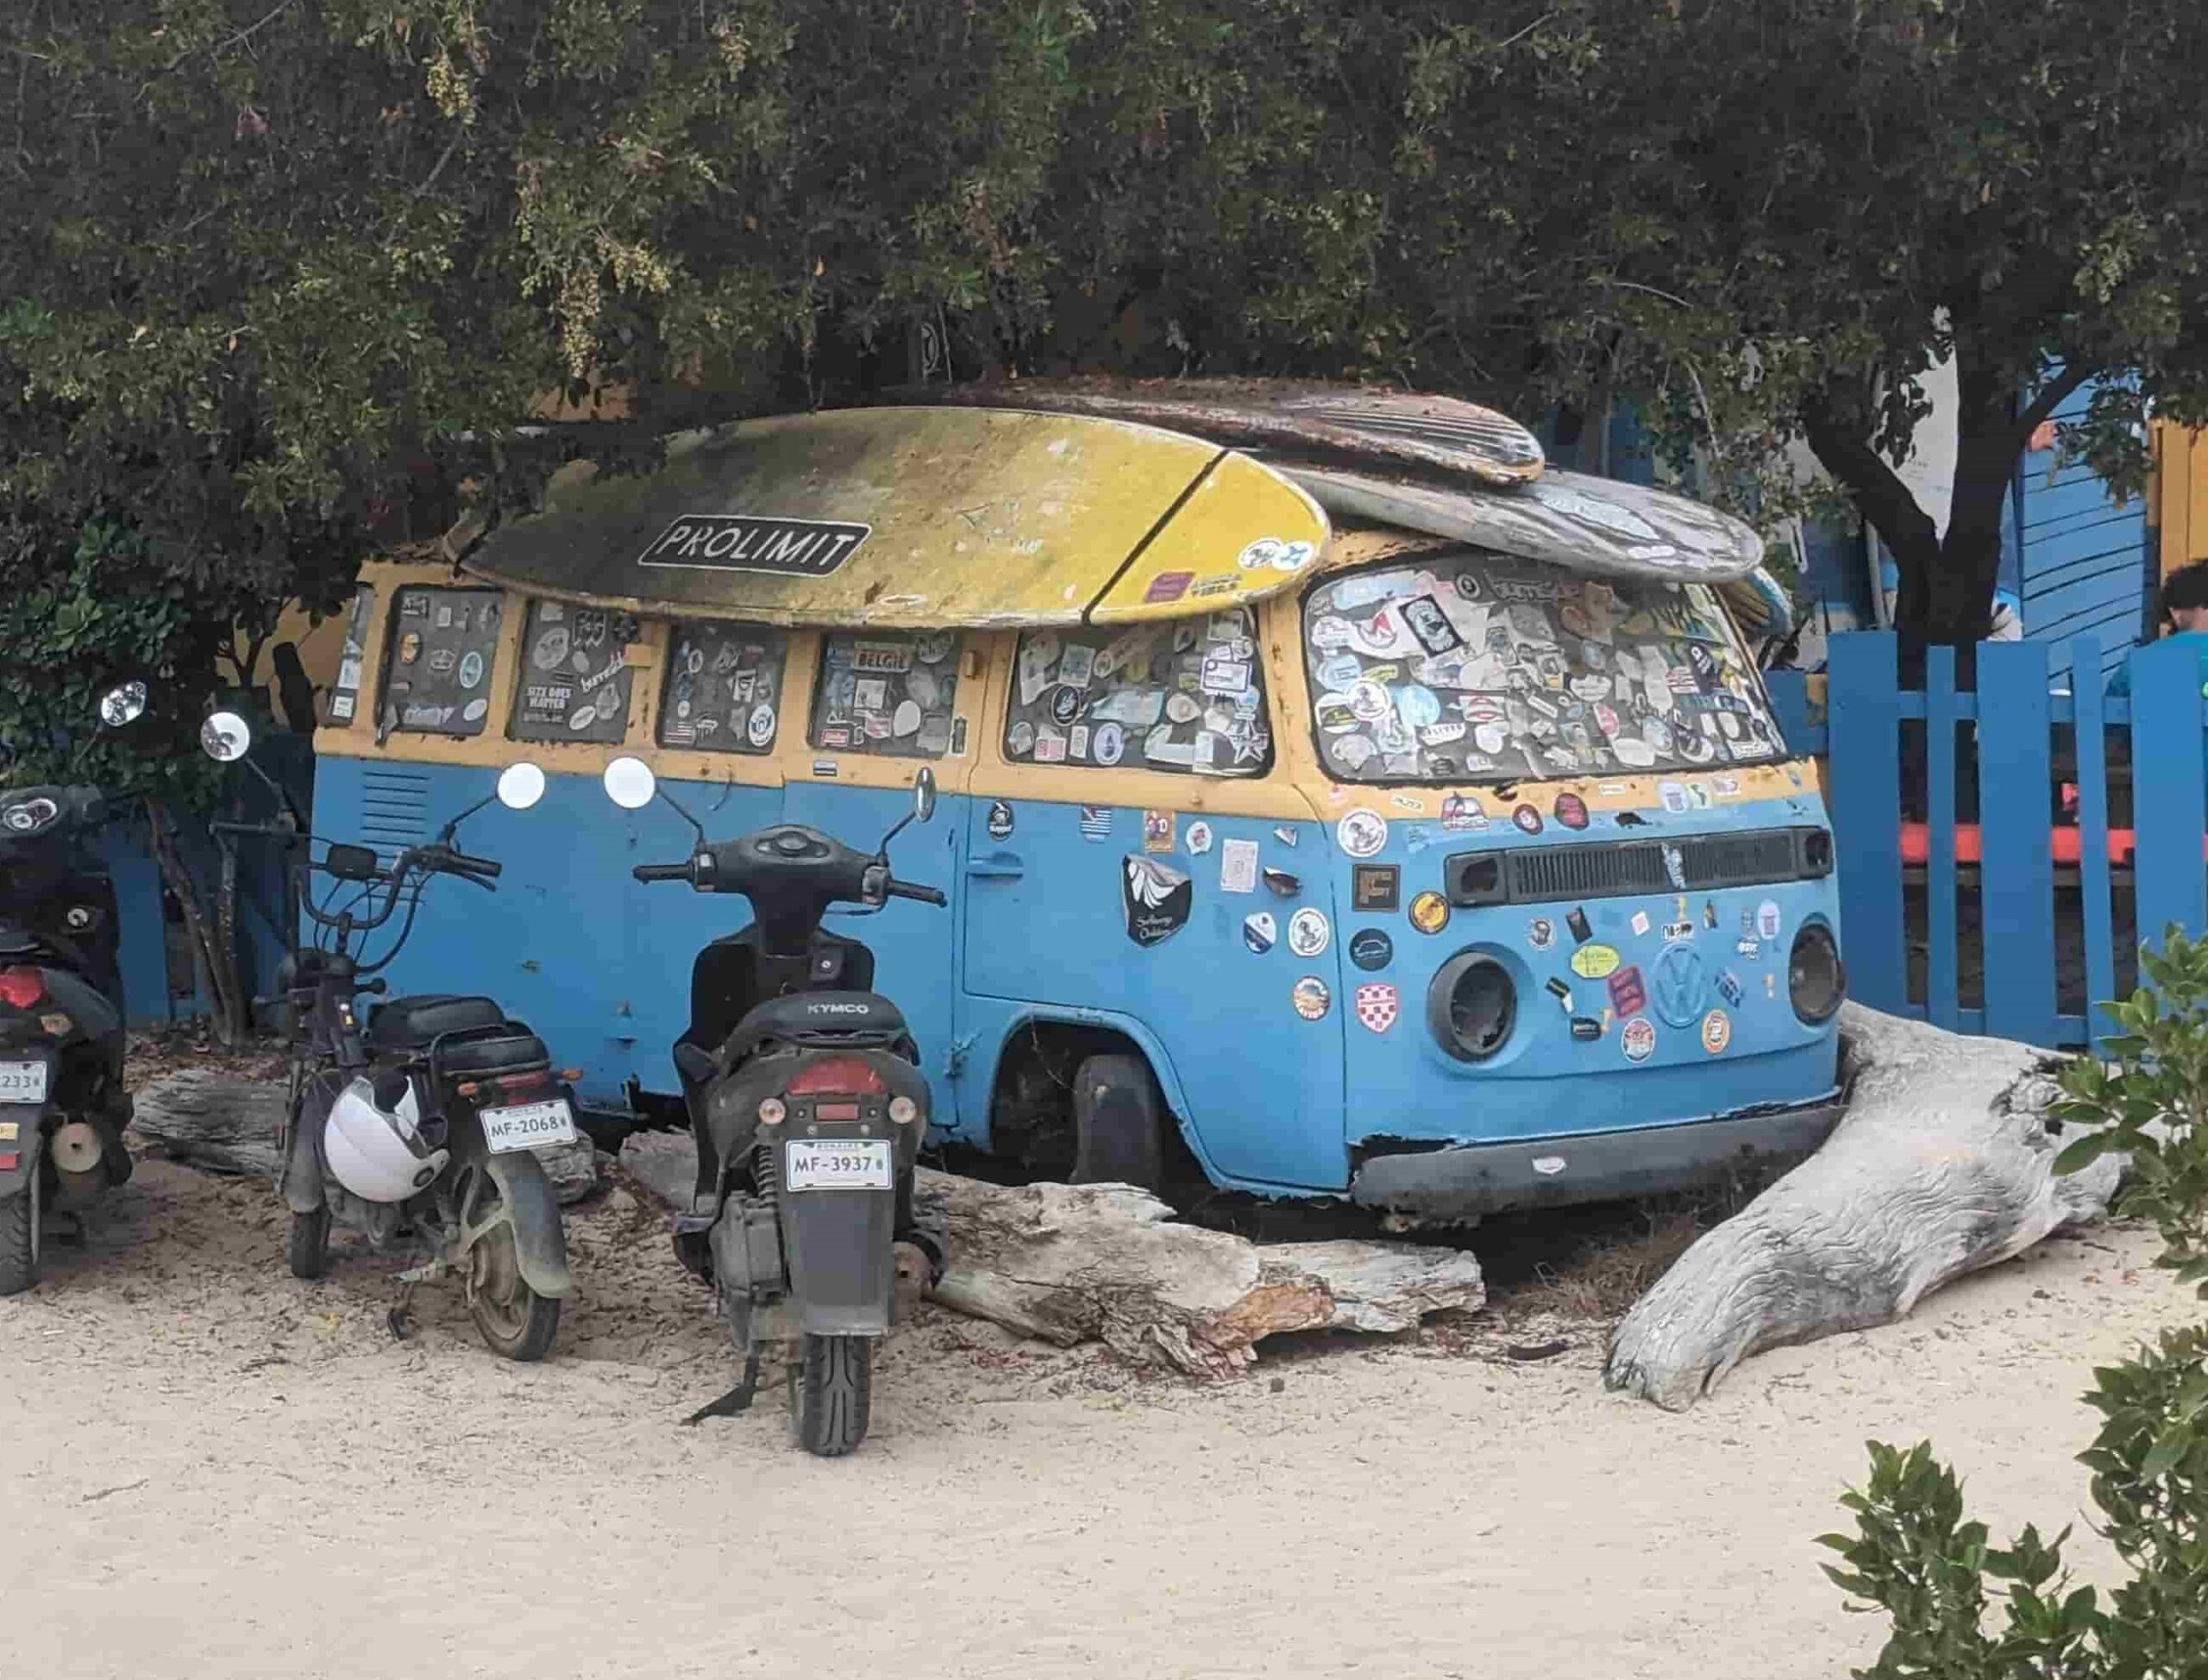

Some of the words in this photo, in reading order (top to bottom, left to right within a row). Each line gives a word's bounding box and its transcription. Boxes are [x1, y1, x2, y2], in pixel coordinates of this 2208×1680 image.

[656, 524, 856, 567] PROLIMIT
[807, 1004, 869, 1014] KYMCO
[0, 1075, 31, 1088] 233
[492, 1116, 560, 1138] MF-2068
[794, 1157, 871, 1172] MF-3937
